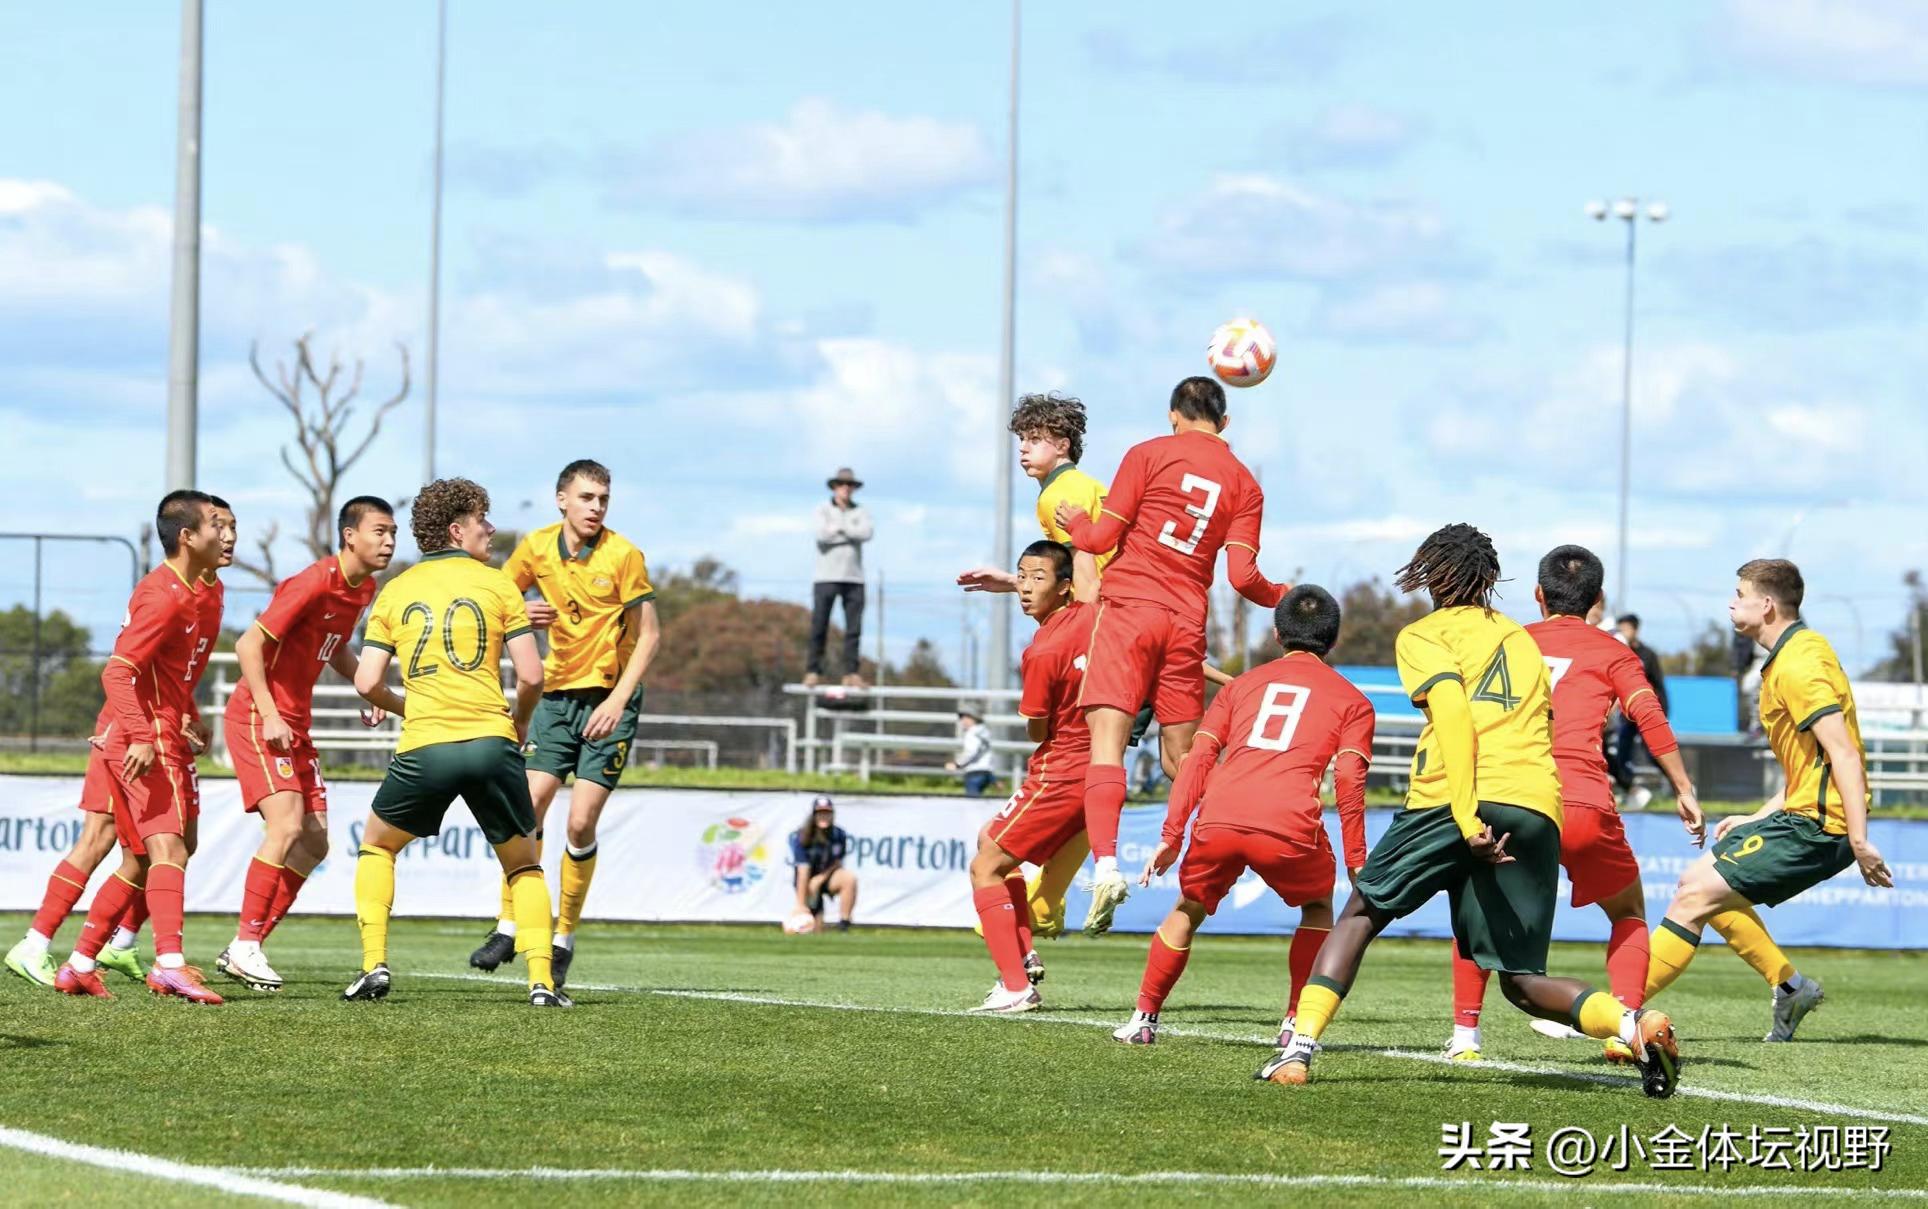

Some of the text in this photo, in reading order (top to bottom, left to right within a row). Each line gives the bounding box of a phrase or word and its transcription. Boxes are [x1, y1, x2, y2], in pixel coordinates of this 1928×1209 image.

[1158, 472, 1222, 556] 3
[567, 599, 583, 626] 3
[316, 632, 342, 662] 10
[402, 597, 488, 680] 20
[1470, 641, 1522, 712] 4
[1246, 682, 1312, 752] 8
[614, 741, 628, 769] 3
[1000, 788, 1025, 819] 6
[1733, 834, 1764, 858] 9
